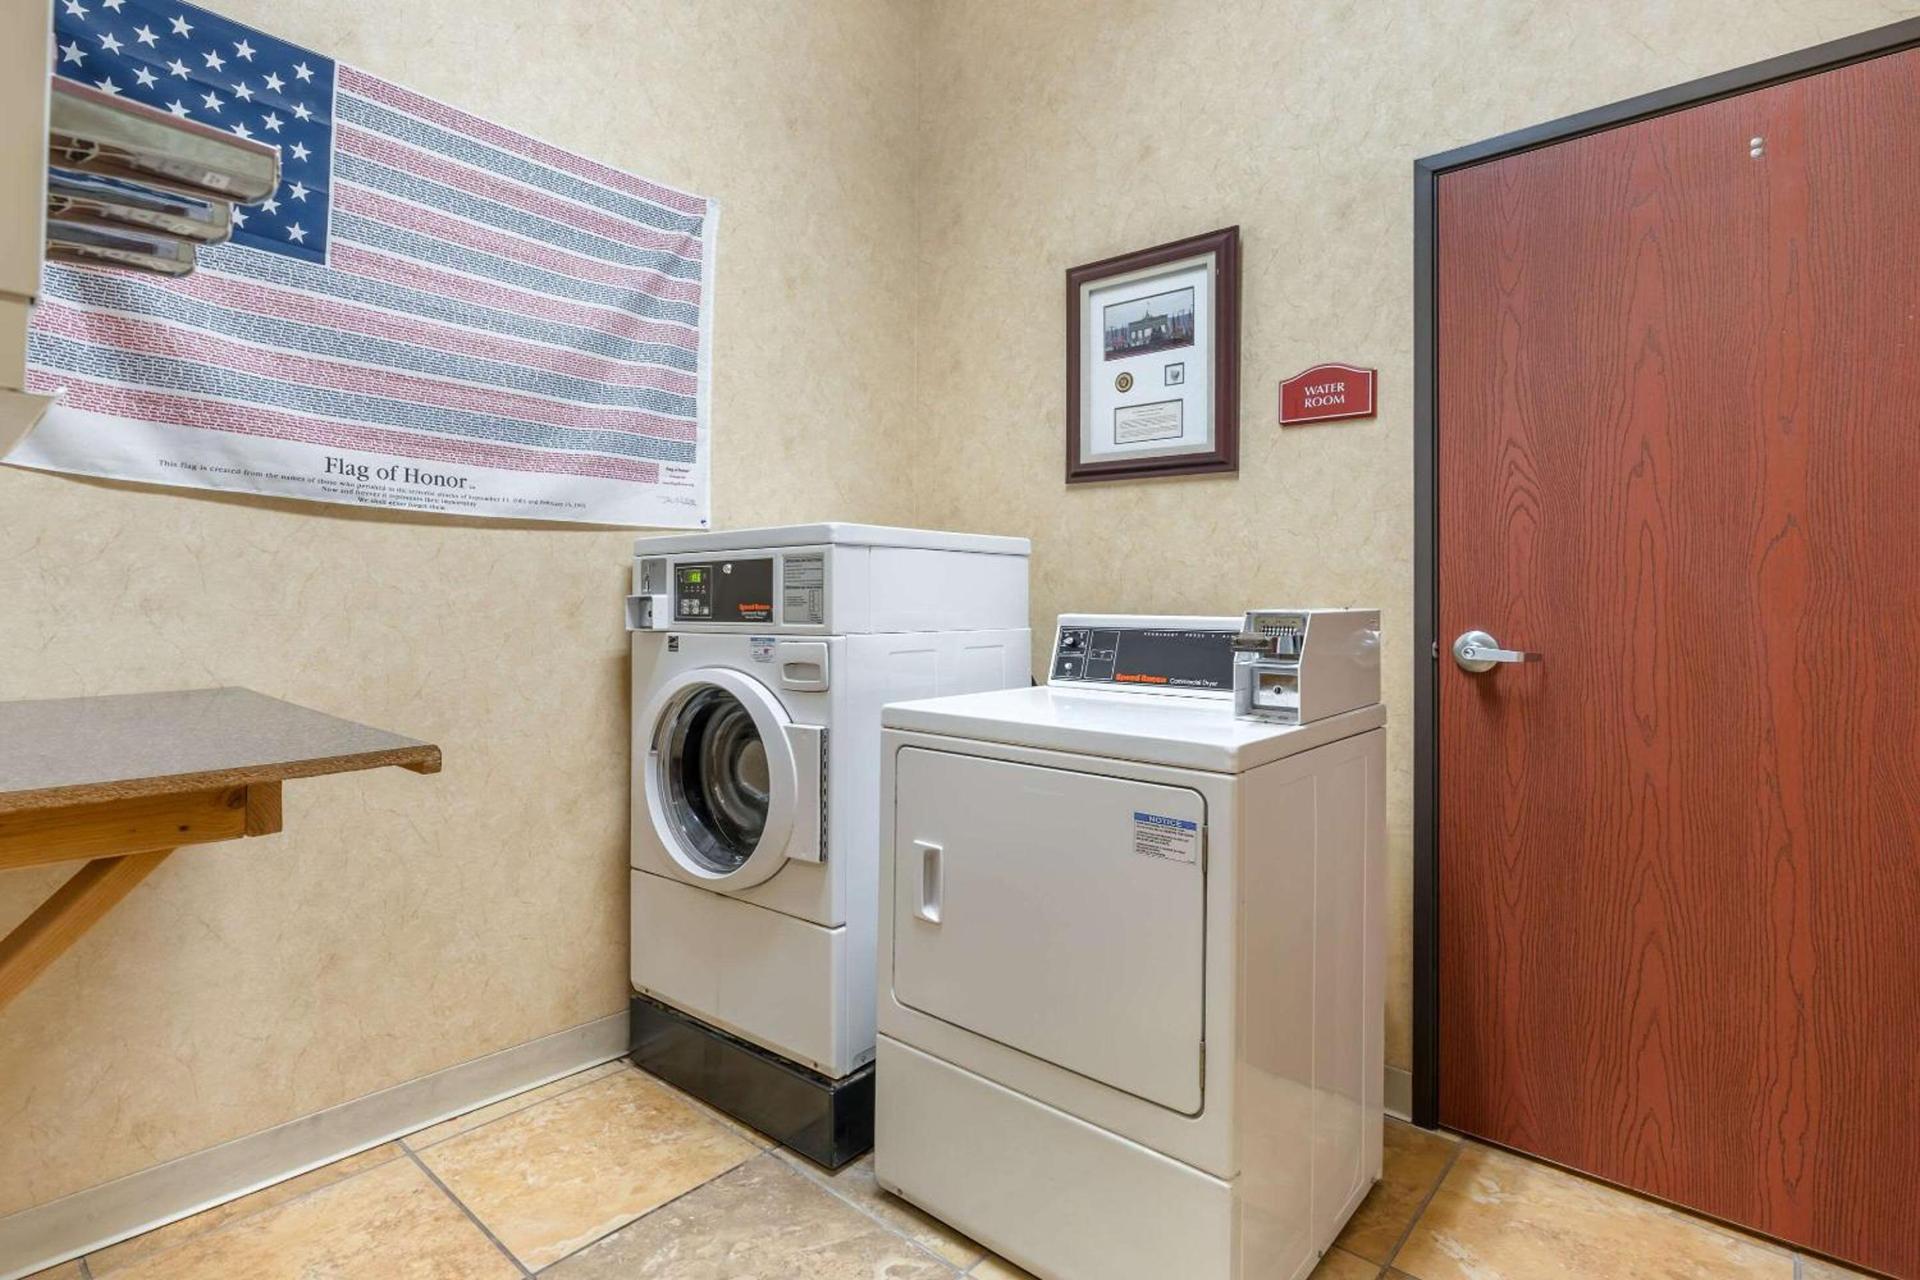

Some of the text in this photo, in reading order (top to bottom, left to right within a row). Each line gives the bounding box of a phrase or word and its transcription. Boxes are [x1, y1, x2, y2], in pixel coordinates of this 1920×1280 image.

[1304, 382, 1345, 396] WATER
[1304, 394, 1345, 408] ROOM
[159, 459, 178, 468] This
[180, 461, 197, 471] flag
[209, 465, 241, 475] created
[243, 468, 263, 477] from
[265, 471, 278, 480] the
[280, 474, 306, 483] names
[307, 476, 316, 484] of
[324, 456, 467, 489] Flag of Honor
[1148, 814, 1183, 828] NOTICE
